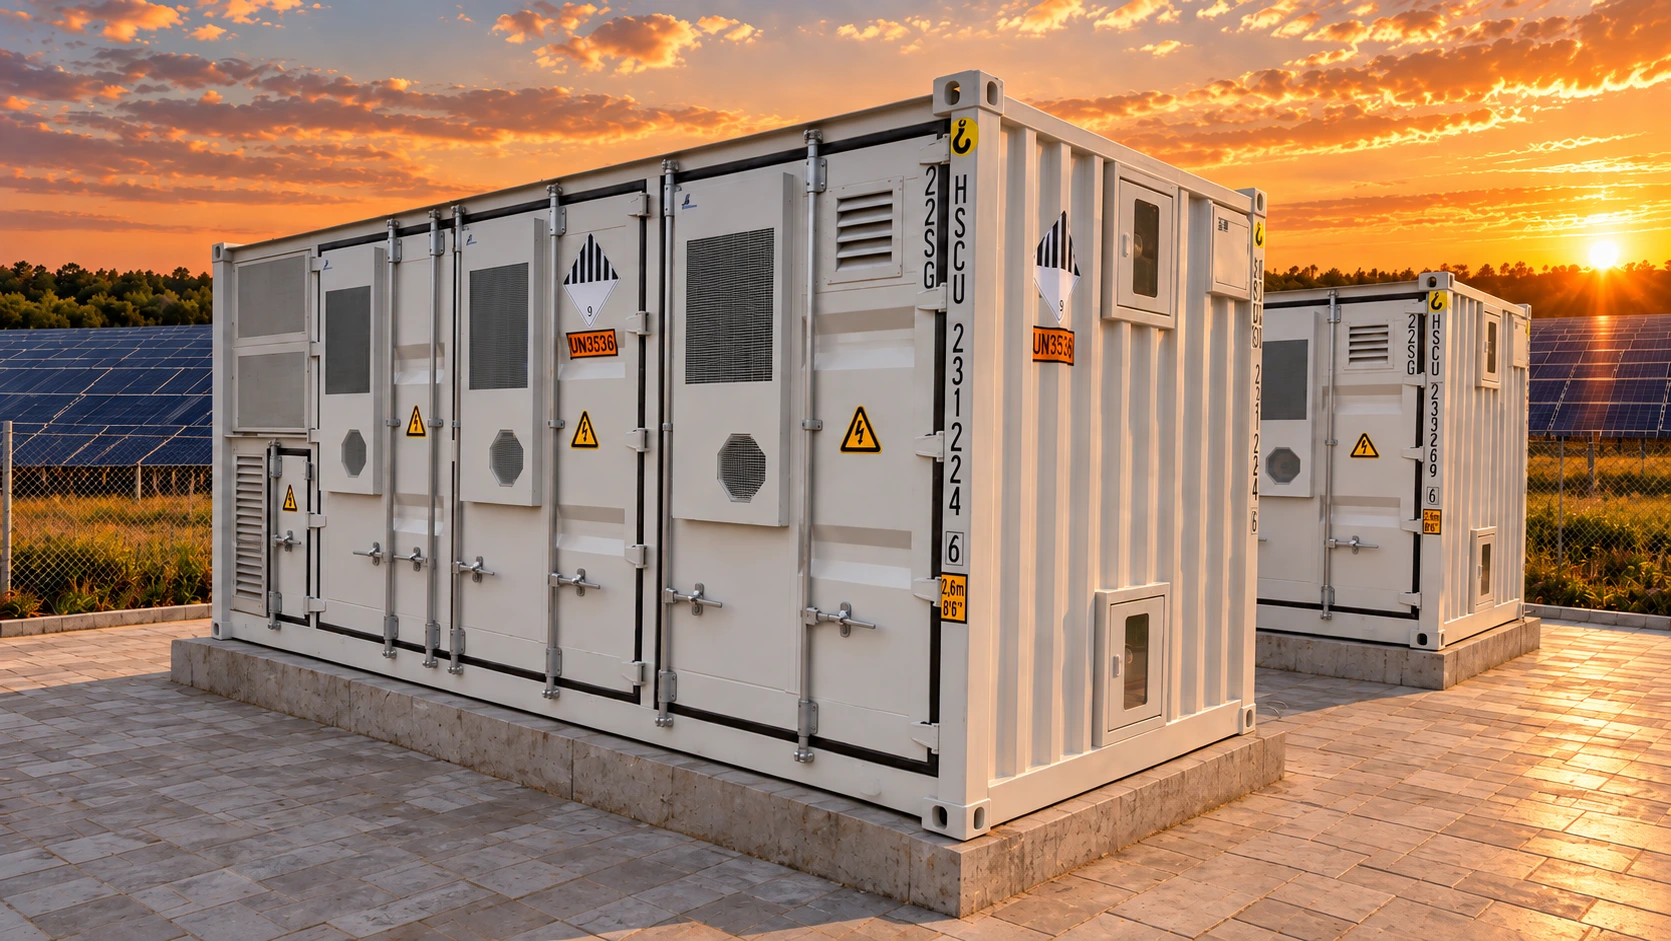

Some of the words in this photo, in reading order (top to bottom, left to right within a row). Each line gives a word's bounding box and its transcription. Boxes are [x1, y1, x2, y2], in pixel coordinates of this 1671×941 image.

[924, 165, 936, 289] 22SG
[952, 174, 967, 304] HSCU
[587, 306, 593, 317] 9
[1060, 300, 1064, 312] 9
[570, 335, 614, 354] UN3536
[1033, 332, 1073, 359] UN3536
[1407, 314, 1416, 375] 22SG
[1432, 314, 1440, 376] HSCU
[949, 323, 964, 515] 231224
[1429, 488, 1436, 503] 6
[1252, 511, 1257, 532] 6
[948, 535, 960, 563] 6
[942, 579, 964, 597] 2,6m
